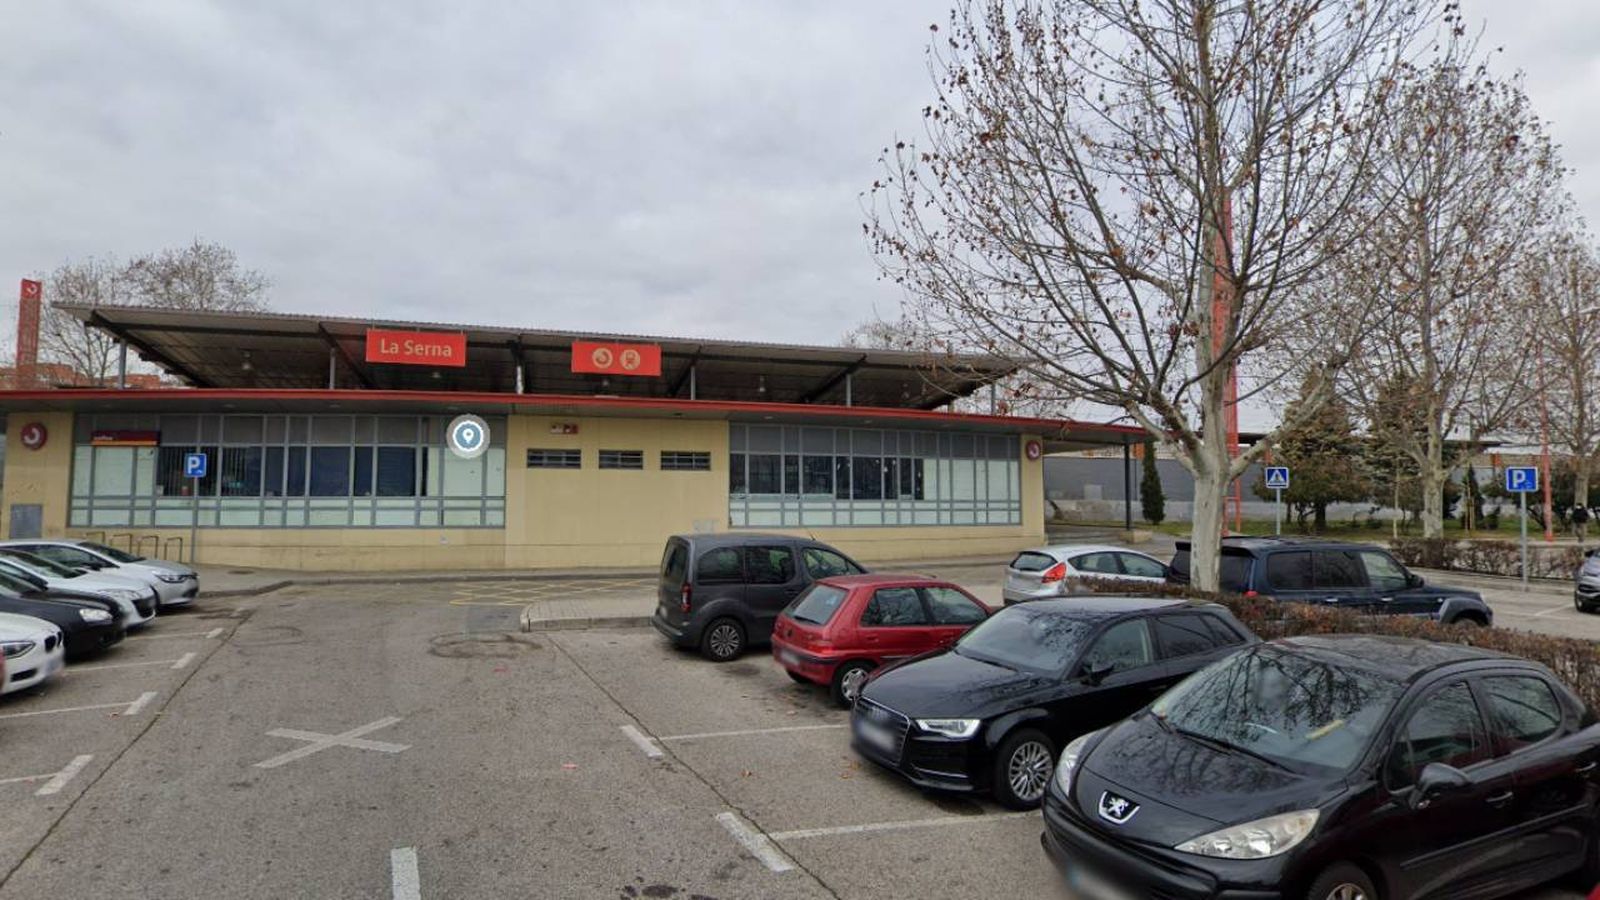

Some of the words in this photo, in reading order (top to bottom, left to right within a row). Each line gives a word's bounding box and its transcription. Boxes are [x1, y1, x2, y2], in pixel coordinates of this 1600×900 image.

[380, 338, 399, 355] La
[404, 339, 452, 358] Serna
[187, 455, 201, 474] P
[1512, 469, 1526, 488] P
